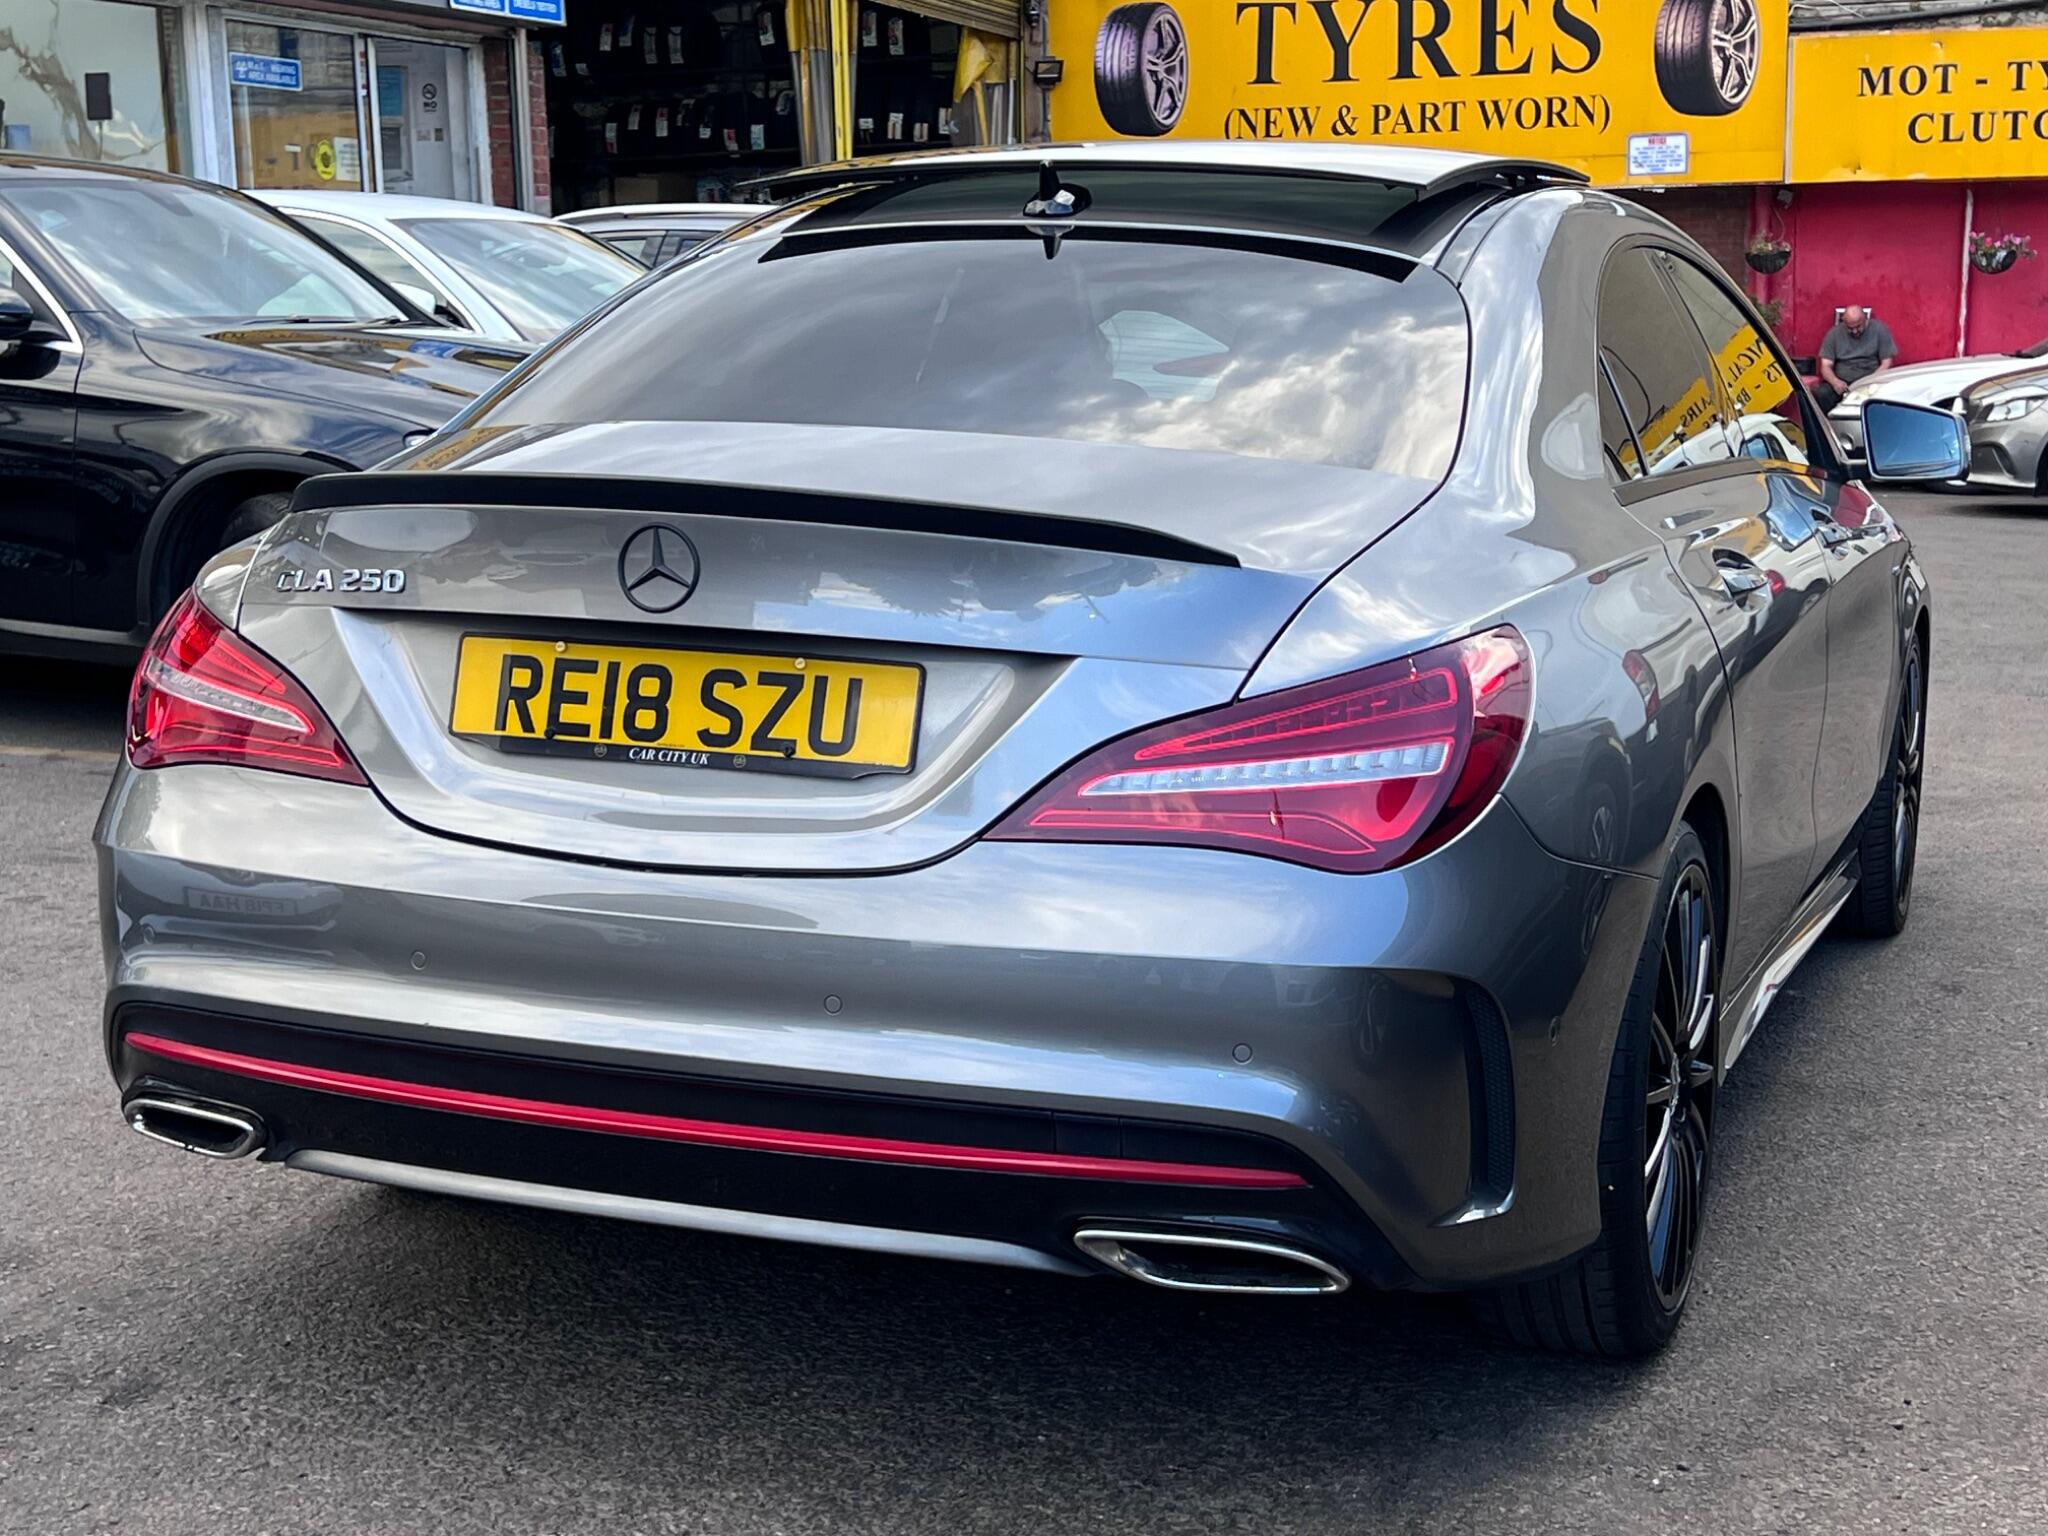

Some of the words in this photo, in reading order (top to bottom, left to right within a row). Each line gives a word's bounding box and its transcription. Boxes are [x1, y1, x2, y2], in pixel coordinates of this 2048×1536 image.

[1236, 0, 1602, 84] TYRES
[1857, 64, 1958, 97] MOT
[1224, 105, 1321, 140] (NEW
[1332, 105, 1358, 136] &
[1372, 101, 1466, 135] PART
[1480, 95, 1611, 134] WORN)
[277, 568, 334, 593] CLA
[339, 568, 406, 593] 250
[494, 653, 673, 743] RE18
[696, 668, 863, 757] SZU
[628, 747, 657, 761] CAR
[658, 749, 692, 763] CITY
[691, 753, 711, 766] UK
